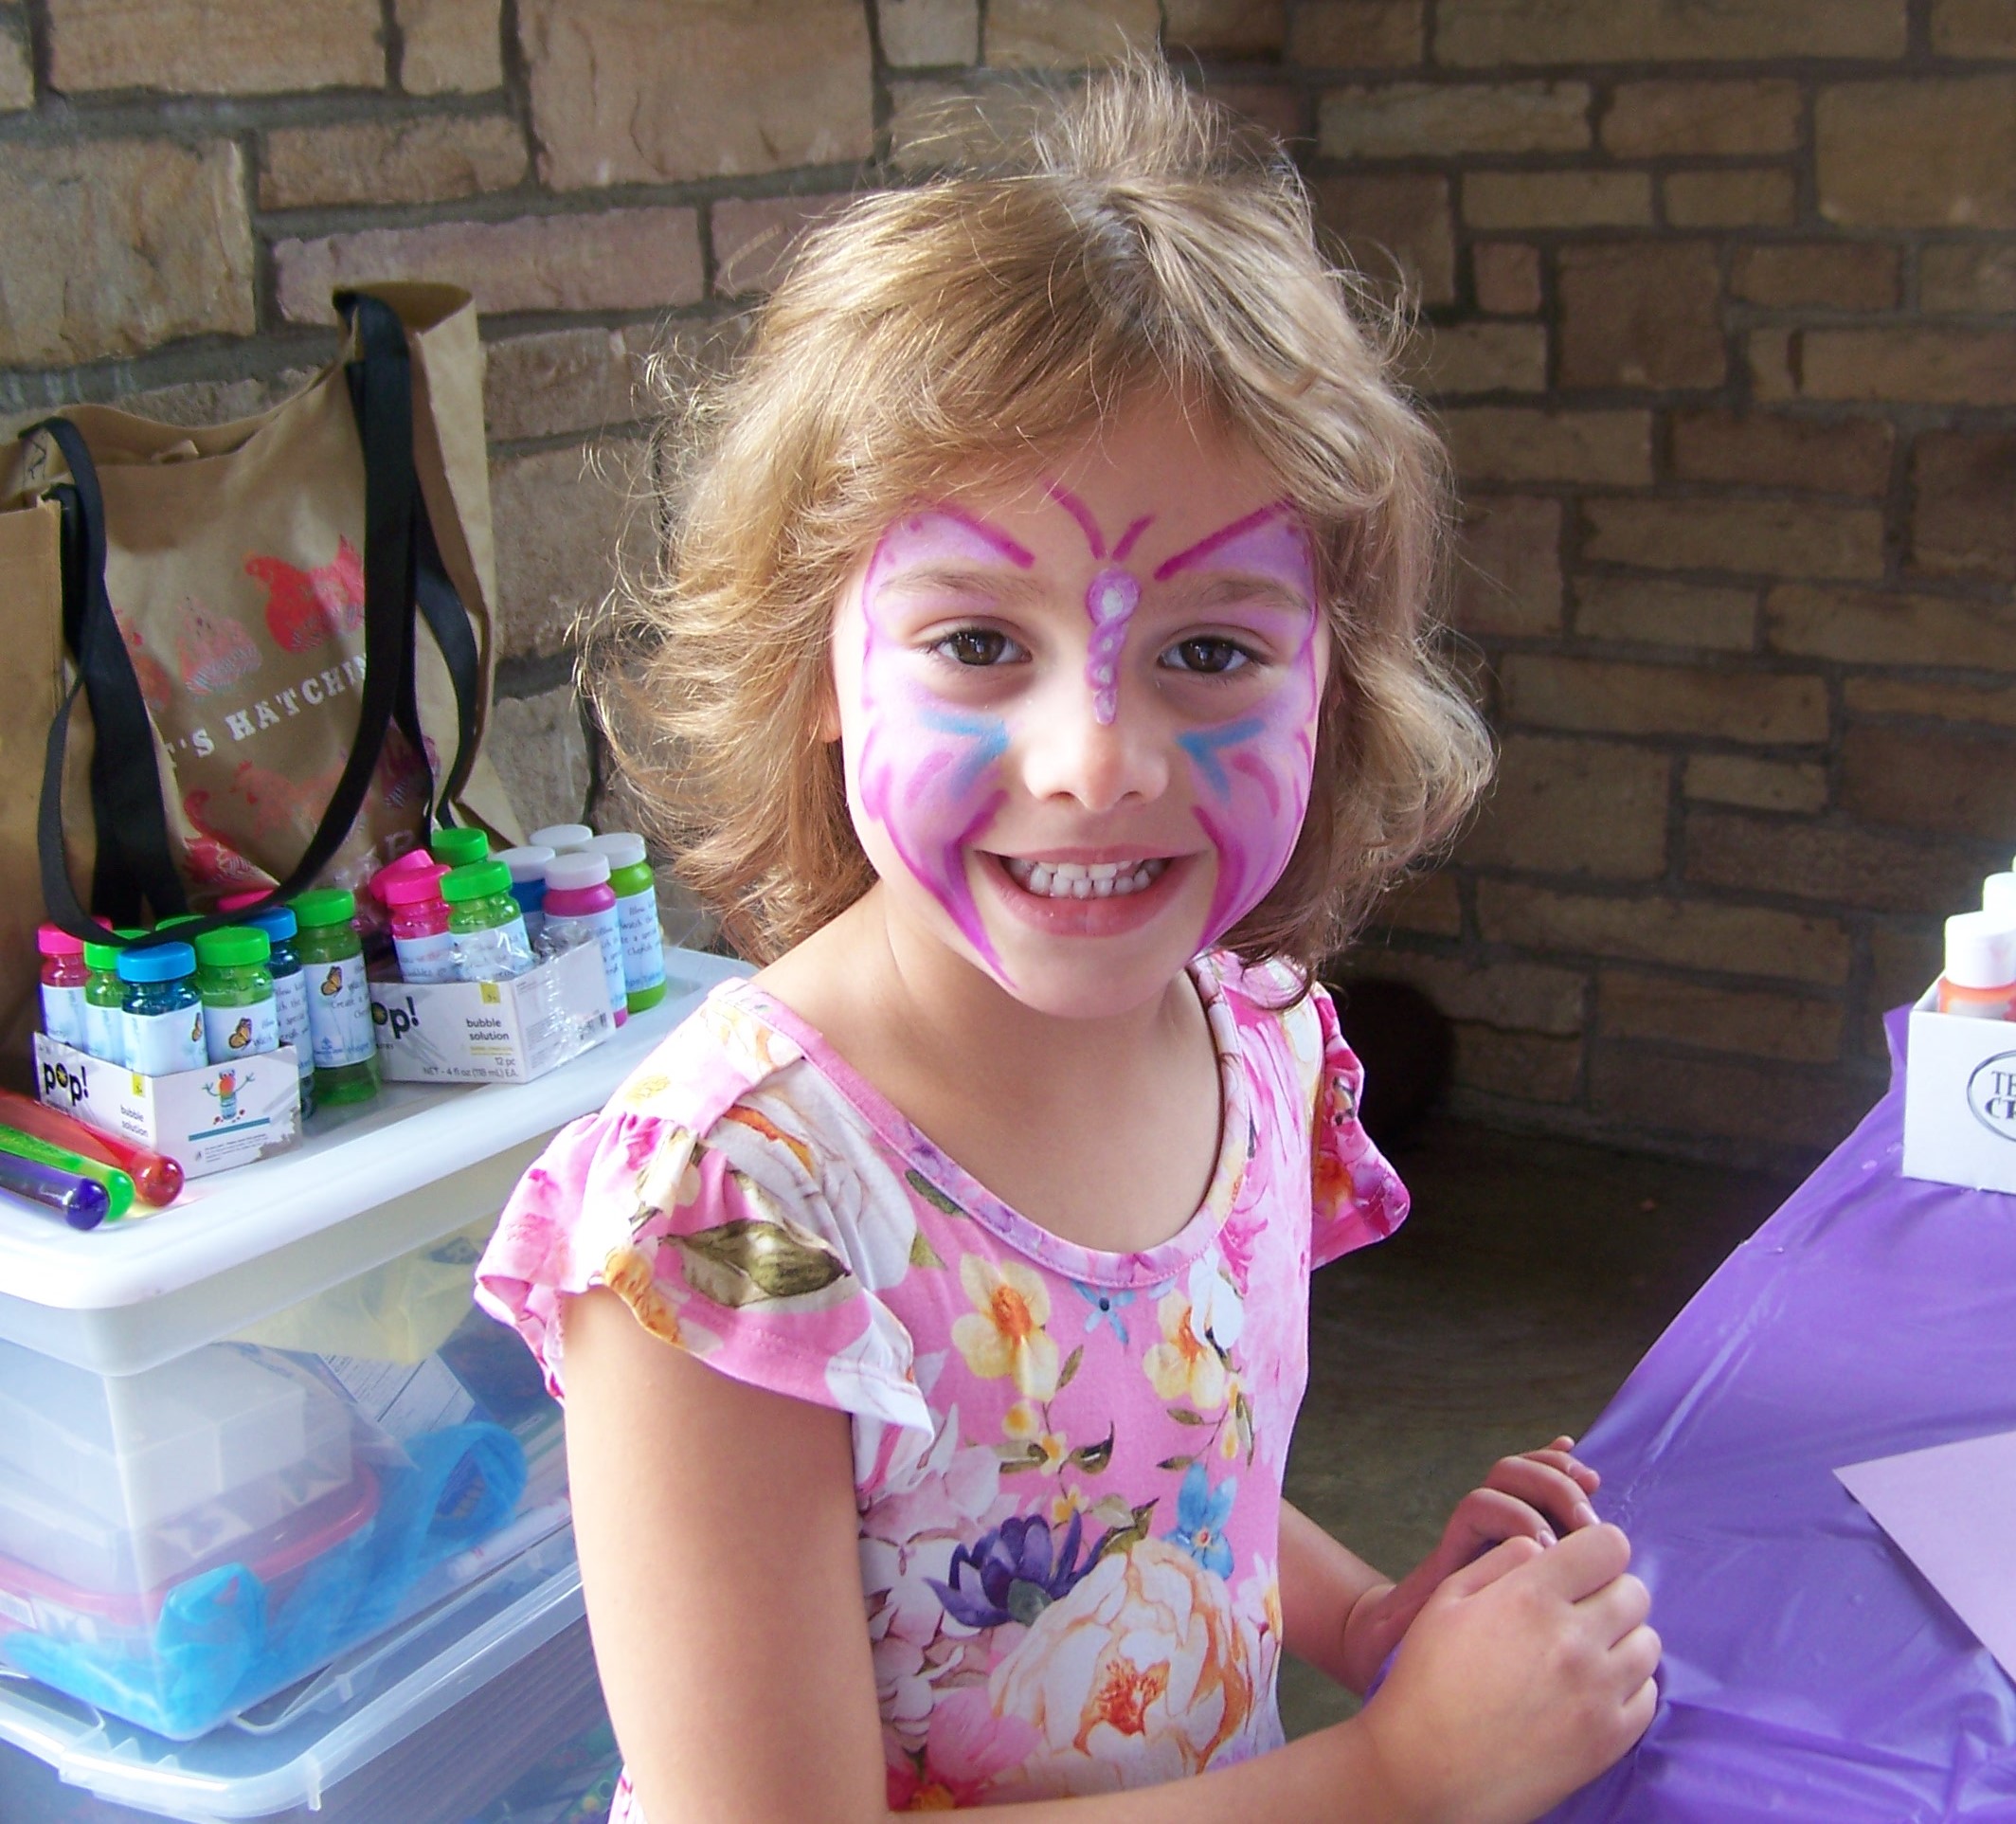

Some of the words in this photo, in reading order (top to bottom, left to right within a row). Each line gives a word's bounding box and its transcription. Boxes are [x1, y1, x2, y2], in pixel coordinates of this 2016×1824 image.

[466, 1017, 502, 1029] bubble
[470, 1031, 510, 1041] solution
[44, 1062, 88, 1107] pop!
[120, 1104, 144, 1122] bubble
[121, 1121, 148, 1138] solution
